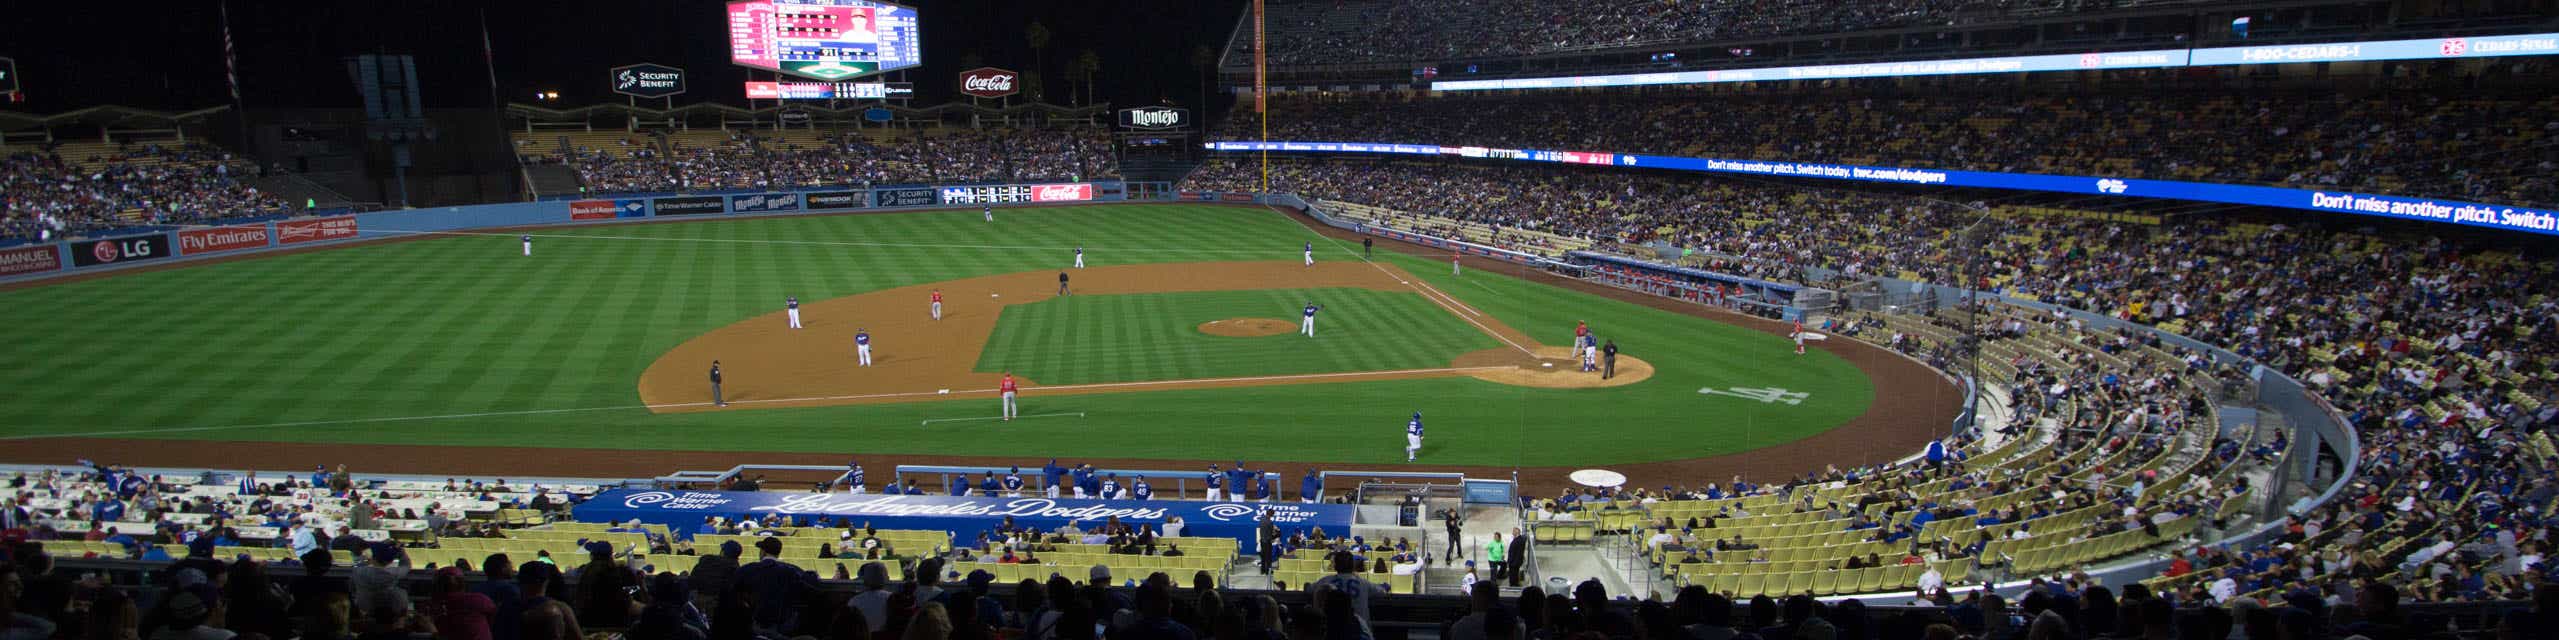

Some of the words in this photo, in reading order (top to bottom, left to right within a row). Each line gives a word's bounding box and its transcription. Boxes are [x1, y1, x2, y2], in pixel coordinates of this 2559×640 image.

[2242, 44, 2361, 60] 1-800-CEDARS-1
[640, 72, 679, 80] SECURITY
[640, 80, 674, 88] BENEFIT
[965, 74, 1013, 91] Coca-Cola
[1131, 109, 1179, 126] Montejo
[1708, 159, 1726, 170] Don't
[1727, 161, 1743, 171] miss
[1744, 162, 1773, 173] another
[1774, 163, 1795, 175] pitch.
[1796, 164, 1824, 175] Switch
[1824, 166, 1850, 178] today.
[1853, 167, 1946, 183] twc.com/dodgers
[572, 207, 590, 215] Bank
[2312, 191, 2353, 209] Don't
[2354, 197, 2389, 213] miss
[2391, 199, 2453, 219] another
[2454, 205, 2498, 223] pitch.
[2500, 208, 2554, 230] Switch
[181, 235, 205, 249] Fly
[207, 229, 266, 246] Emirates
[0, 249, 54, 266] MANUEL
[123, 240, 151, 258] LG
[827, 495, 996, 516] Angeles
[988, 498, 1168, 520] Dodgers
